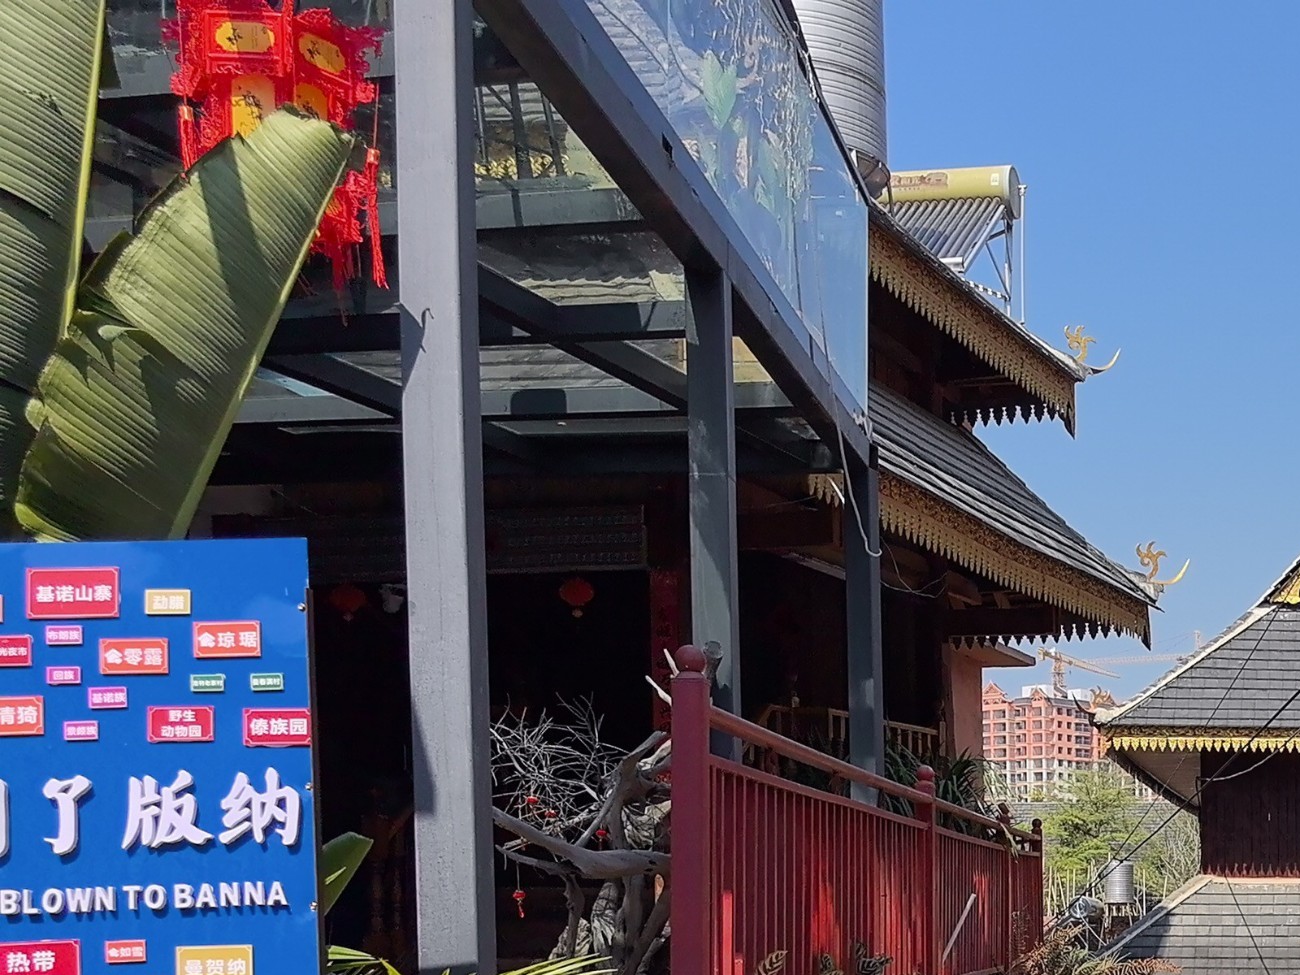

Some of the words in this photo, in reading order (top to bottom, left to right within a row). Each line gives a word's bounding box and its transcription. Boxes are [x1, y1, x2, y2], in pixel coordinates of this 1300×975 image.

[36, 584, 113, 603] 基诺山寨
[217, 631, 258, 649] 琼琚
[124, 647, 163, 667] 零露
[53, 669, 75, 680] 回族
[92, 692, 126, 704] 基诺族
[168, 709, 197, 722] 野生
[160, 724, 202, 738] 动物园
[249, 718, 308, 736] 傣族园
[0, 767, 302, 857] 了版纳
[0, 886, 116, 915] BLOWN
[122, 883, 167, 911] TO
[174, 881, 288, 909] BANNA
[7, 950, 56, 973] 热带
